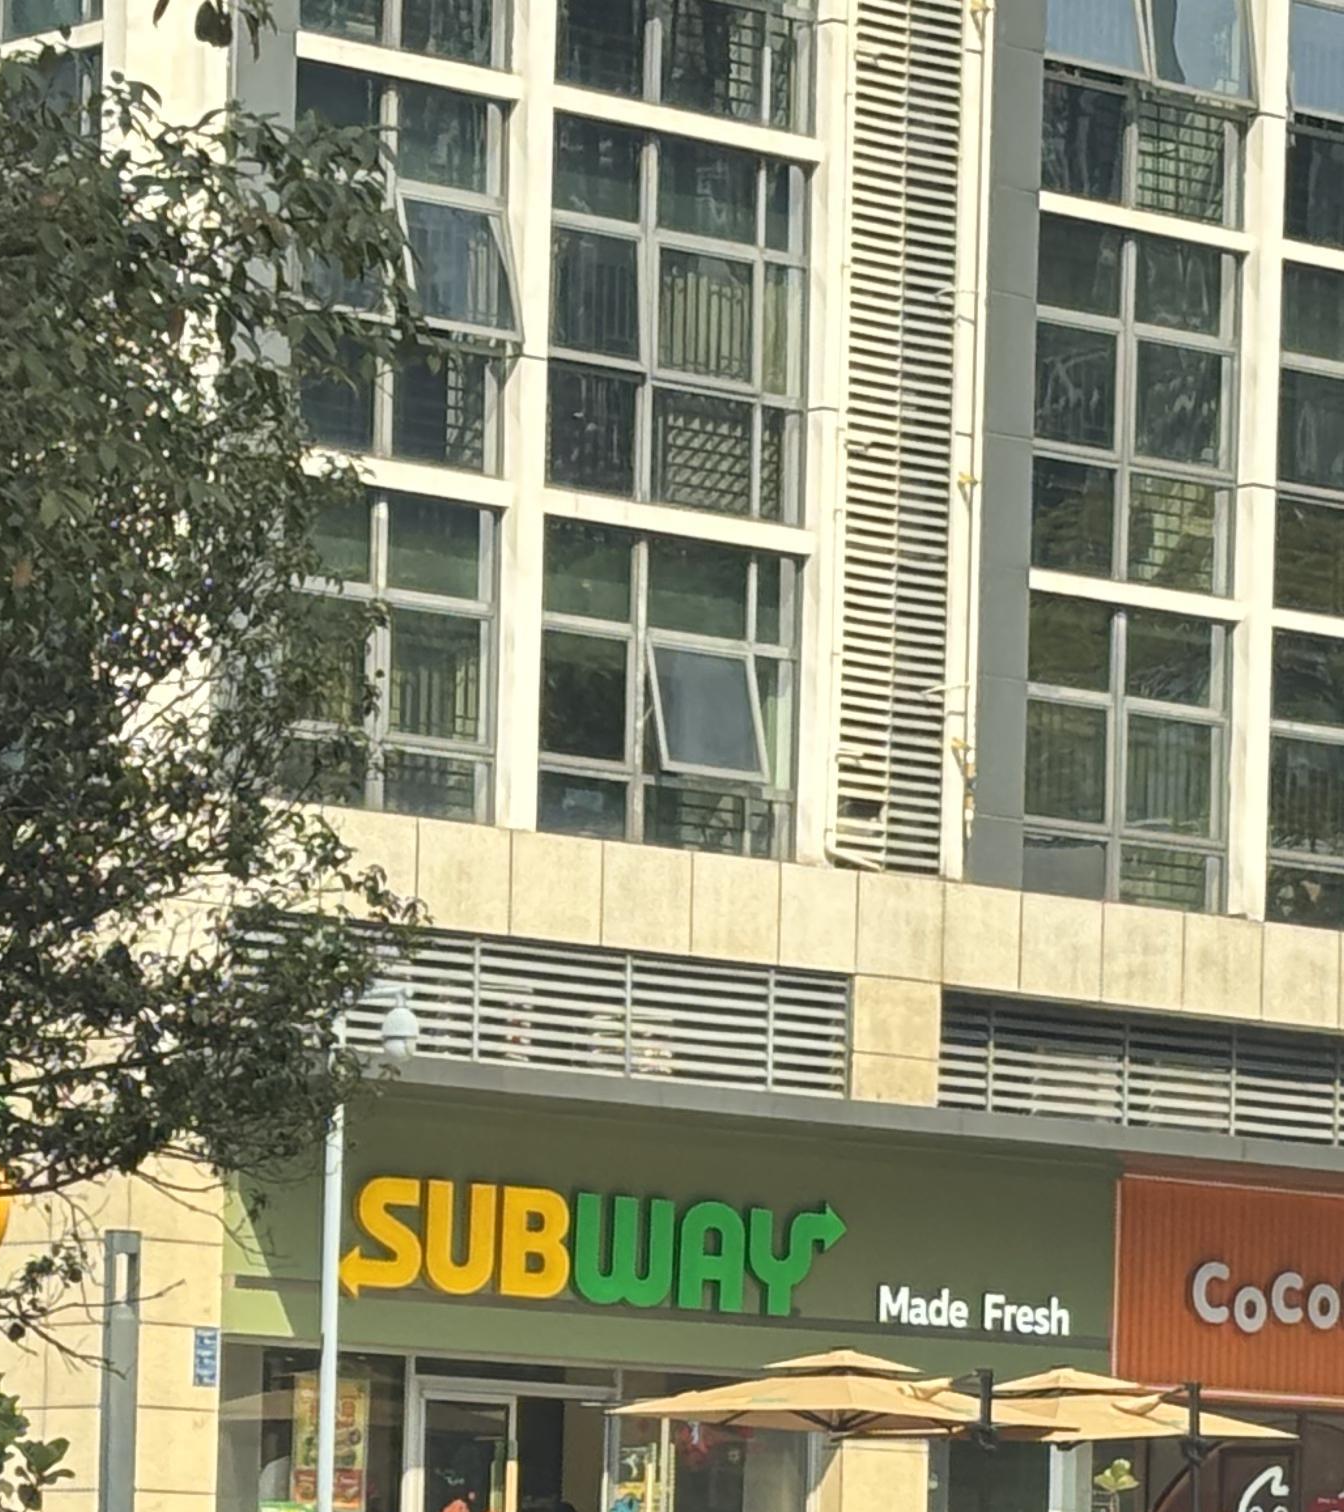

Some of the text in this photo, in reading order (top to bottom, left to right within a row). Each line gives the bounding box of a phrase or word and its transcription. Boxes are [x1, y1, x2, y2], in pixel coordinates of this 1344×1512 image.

[339, 1176, 848, 1317] SUBWAY
[878, 1285, 1070, 1337] Made Fresh
